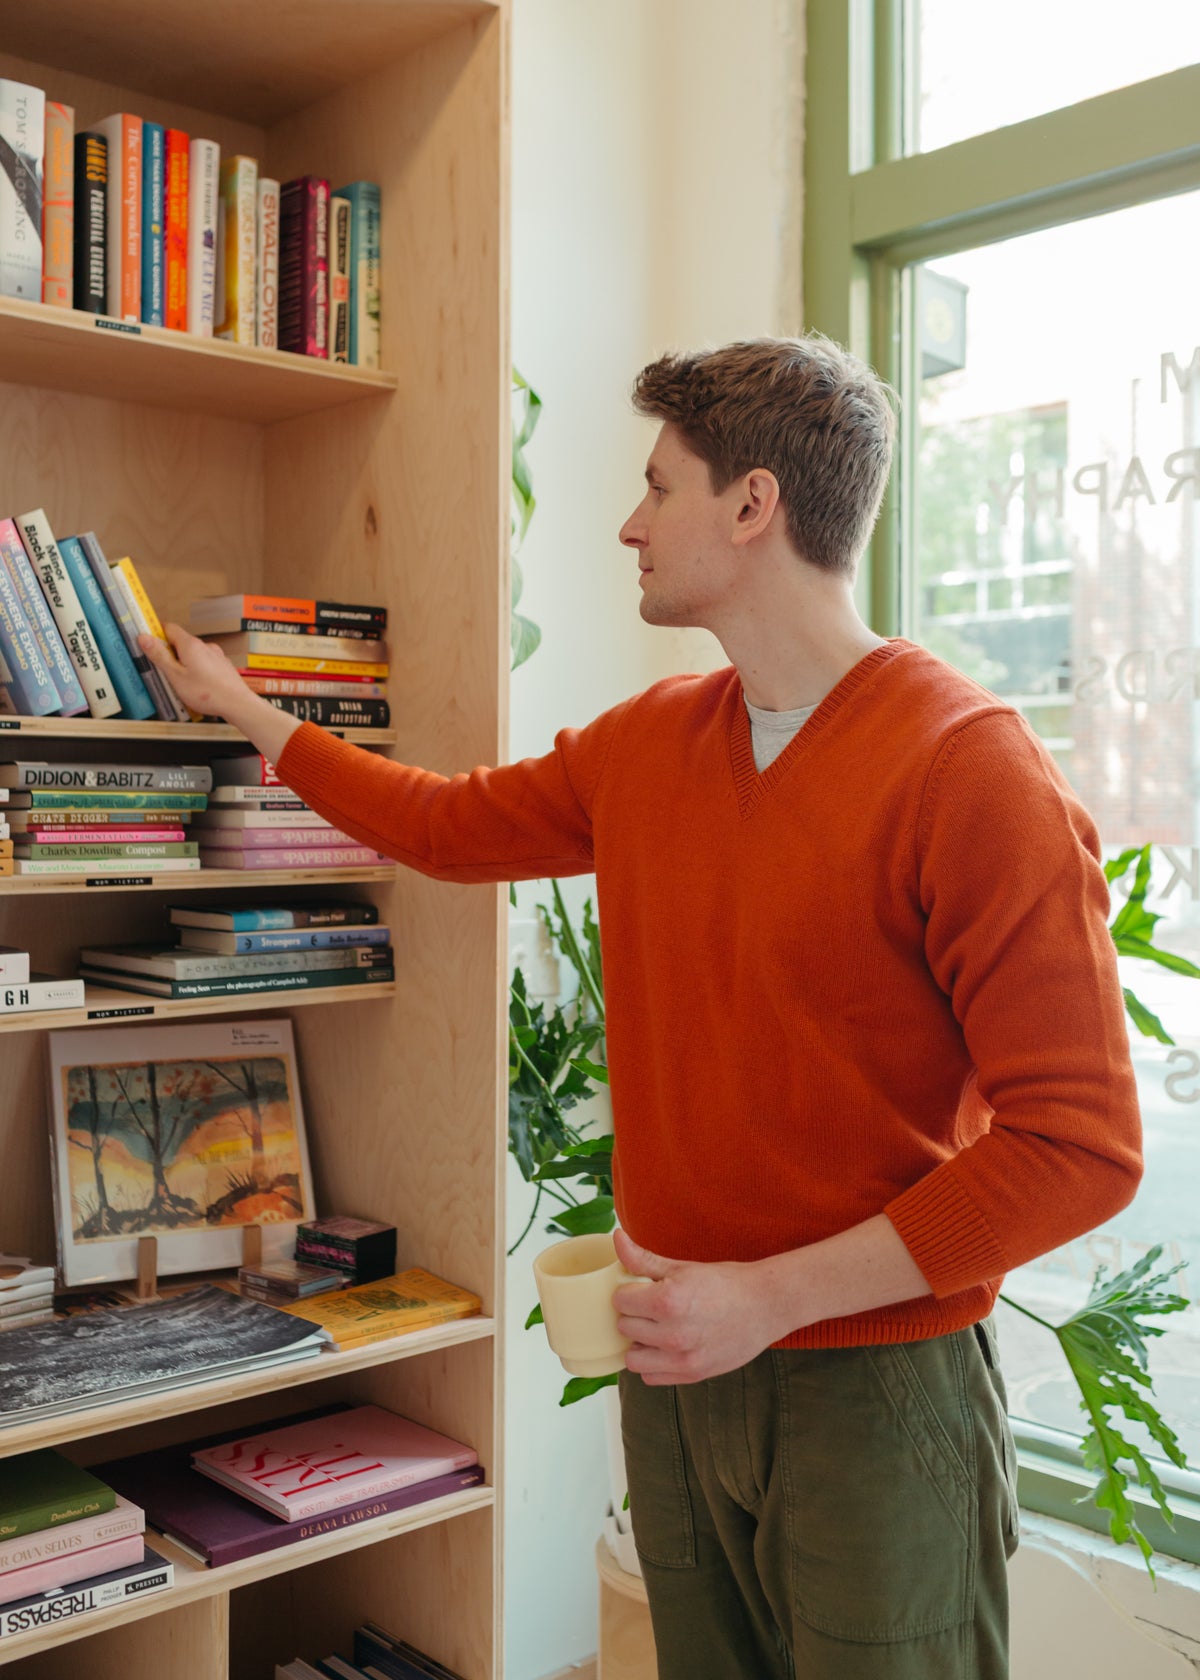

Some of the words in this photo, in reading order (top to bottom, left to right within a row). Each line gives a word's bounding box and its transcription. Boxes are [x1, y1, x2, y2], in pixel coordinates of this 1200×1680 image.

[14, 96, 28, 150] TOM'S
[127, 127, 140, 153] The
[152, 130, 161, 157] MORE
[86, 138, 107, 183] JAMES
[152, 159, 161, 182] THAN
[14, 155, 27, 242] CROSSING
[125, 156, 139, 256] Correspondent
[152, 183, 161, 222] ENOUGH
[90, 189, 104, 244] PERCIVAL
[152, 238, 161, 264] ANNA
[90, 247, 104, 298] EVERETT
[201, 250, 213, 287] PLAY
[262, 193, 277, 347] SWALLOWS
[24, 525, 44, 562] Black
[40, 565, 64, 609] Figures
[46, 544, 65, 581] Minor
[69, 545, 90, 579] Small
[84, 578, 101, 605] Rain
[5, 530, 19, 556] THE
[15, 555, 50, 629] ELSEWHERE
[45, 629, 72, 684] EXPRESS
[23, 601, 39, 630] SOTTO
[10, 633, 28, 669] YAMBAO
[20, 631, 48, 686] EXPRESS
[67, 631, 88, 669] Taylor
[75, 620, 101, 672] Brandon
[265, 680, 279, 692] Oh
[281, 681, 294, 694] My
[331, 714, 372, 724] GOLDSTONE
[159, 780, 196, 789] ANOLIK
[168, 772, 188, 780] LILI
[32, 814, 65, 823] CRATE
[70, 813, 108, 823] DIGGER
[40, 846, 77, 856] Charles
[79, 845, 122, 857] Dowding
[126, 844, 166, 856] Compost
[68, 833, 134, 841] FERMENTATION
[281, 831, 332, 844] PAPER
[283, 852, 333, 865] PAPER
[261, 936, 300, 948] Strangers
[178, 985, 197, 994] Feeling
[197, 985, 211, 993] Seen
[226, 982, 235, 990] the
[84, 1502, 100, 1513] Club
[300, 1519, 338, 1538] DEANA
[342, 1502, 388, 1525] LAWSON
[12, 1546, 43, 1564] OWN
[45, 1534, 83, 1556] SELVES
[135, 1577, 164, 1591] PRESTEL
[7, 1590, 97, 1633] TRESPASS
